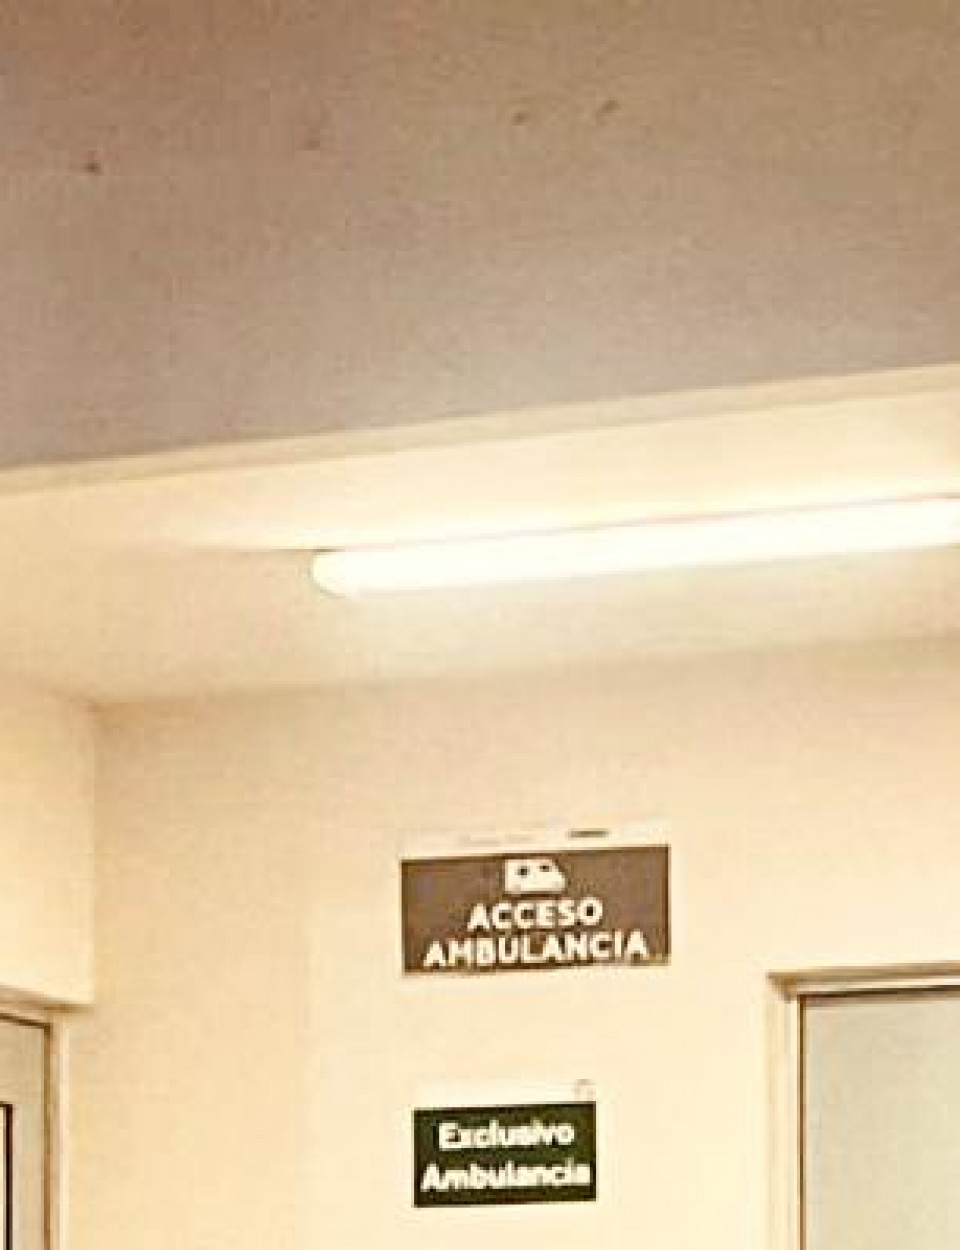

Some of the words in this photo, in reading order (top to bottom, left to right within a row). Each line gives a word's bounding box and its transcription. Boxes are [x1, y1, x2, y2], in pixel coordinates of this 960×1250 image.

[467, 897, 604, 931] ACCESO
[423, 930, 650, 967] AMBULANCIA
[438, 1118, 575, 1150] Exclusivo
[419, 1157, 591, 1193] Ambulancia
